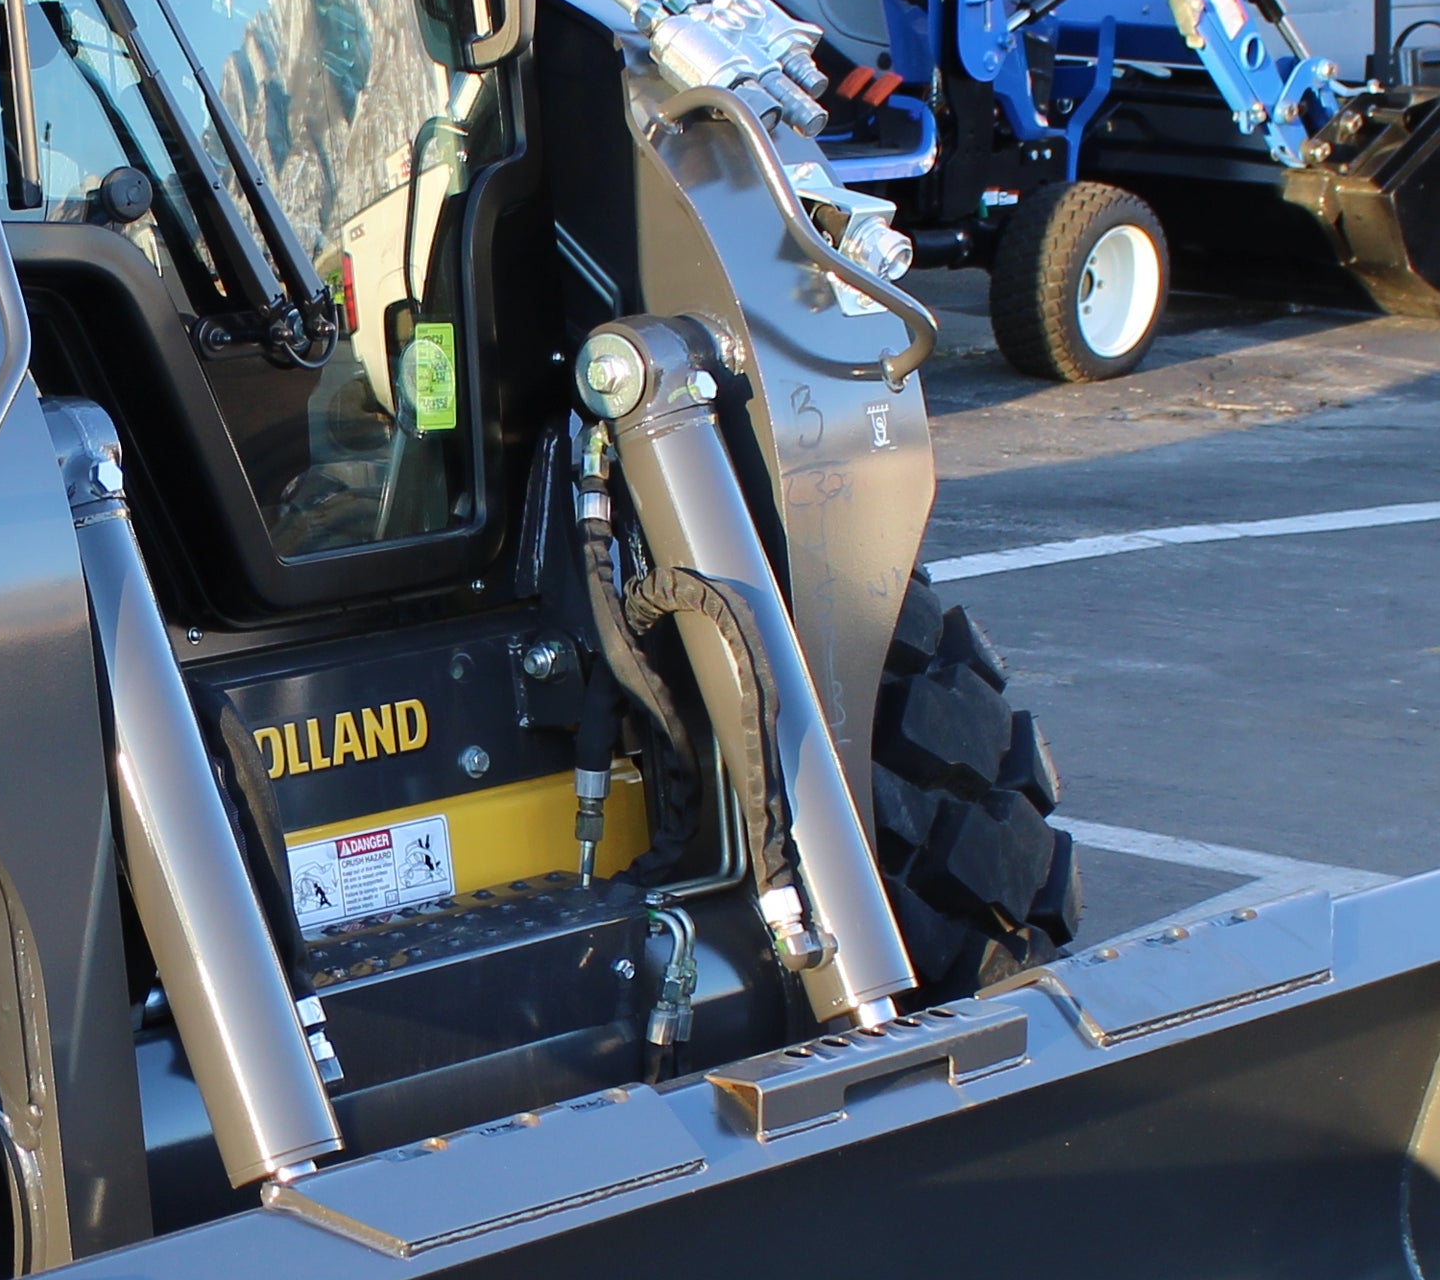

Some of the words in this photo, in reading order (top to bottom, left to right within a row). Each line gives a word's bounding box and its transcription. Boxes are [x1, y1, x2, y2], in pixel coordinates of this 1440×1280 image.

[253, 698, 428, 780] OLLAND
[350, 833, 390, 856] DANGER
[341, 856, 365, 869] CRUSH
[365, 850, 392, 864] HAZARD
